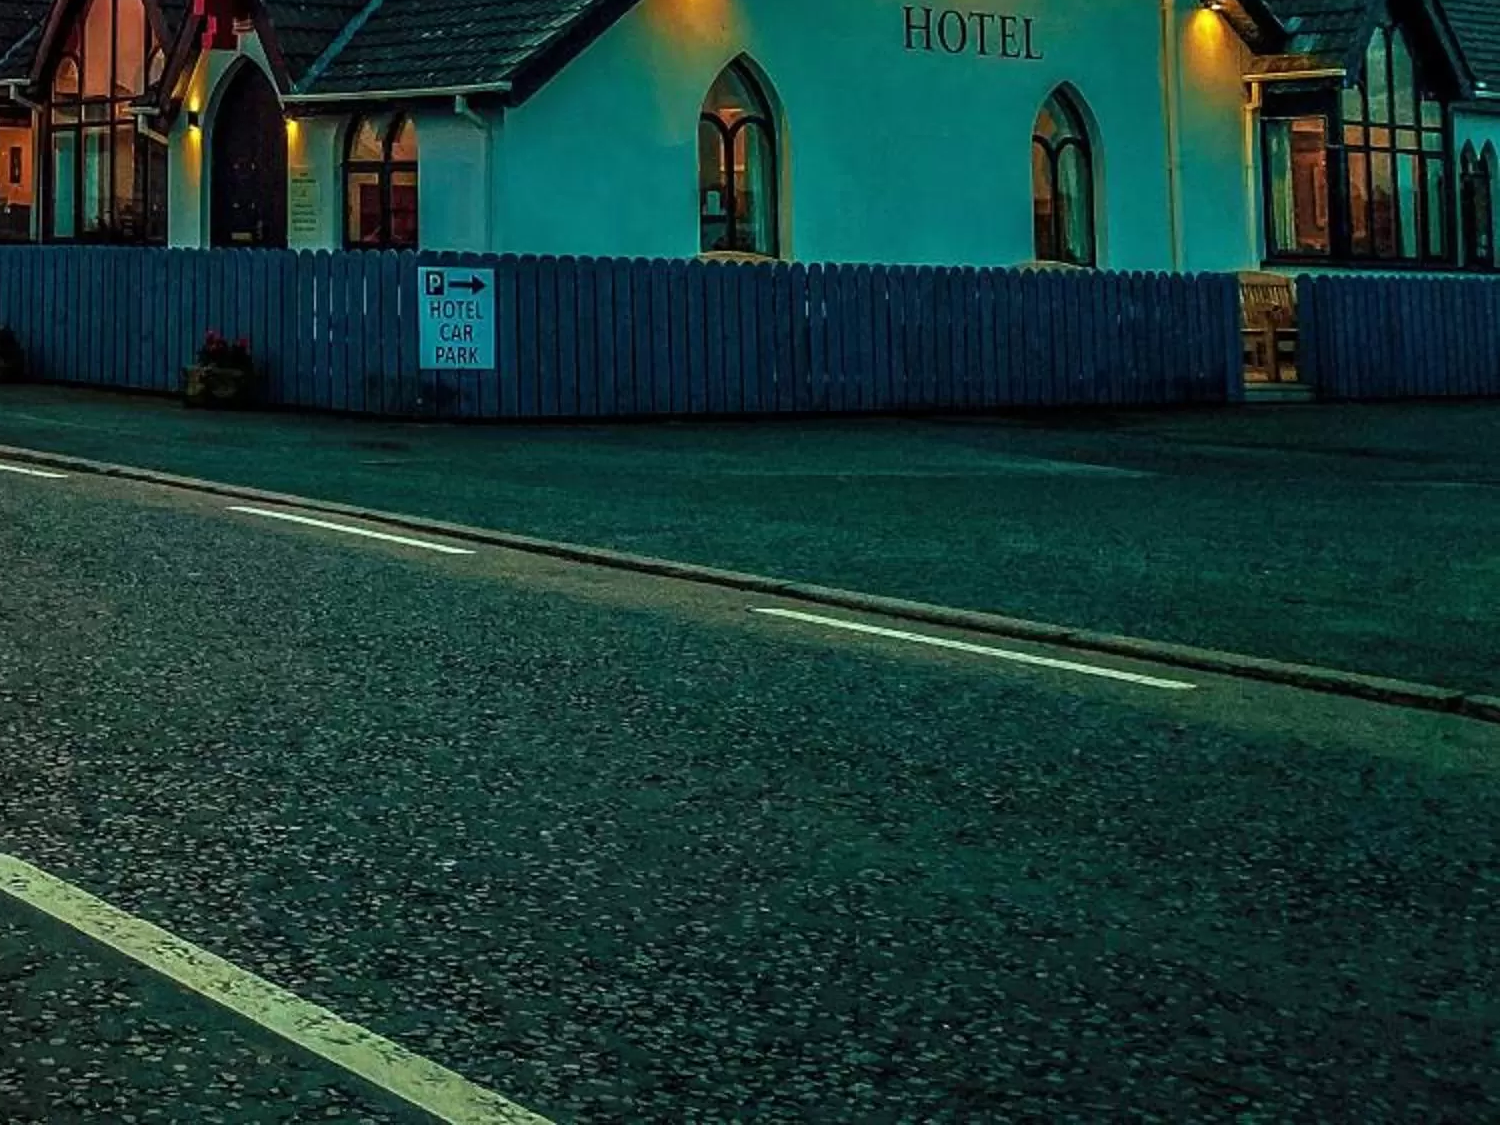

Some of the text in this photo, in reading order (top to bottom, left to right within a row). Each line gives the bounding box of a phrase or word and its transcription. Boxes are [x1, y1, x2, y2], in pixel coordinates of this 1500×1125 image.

[902, 6, 1044, 60] HOTEL
[429, 274, 442, 294] P
[429, 300, 484, 320] HOTEL
[440, 323, 473, 342] CAR
[435, 346, 480, 364] PARK
